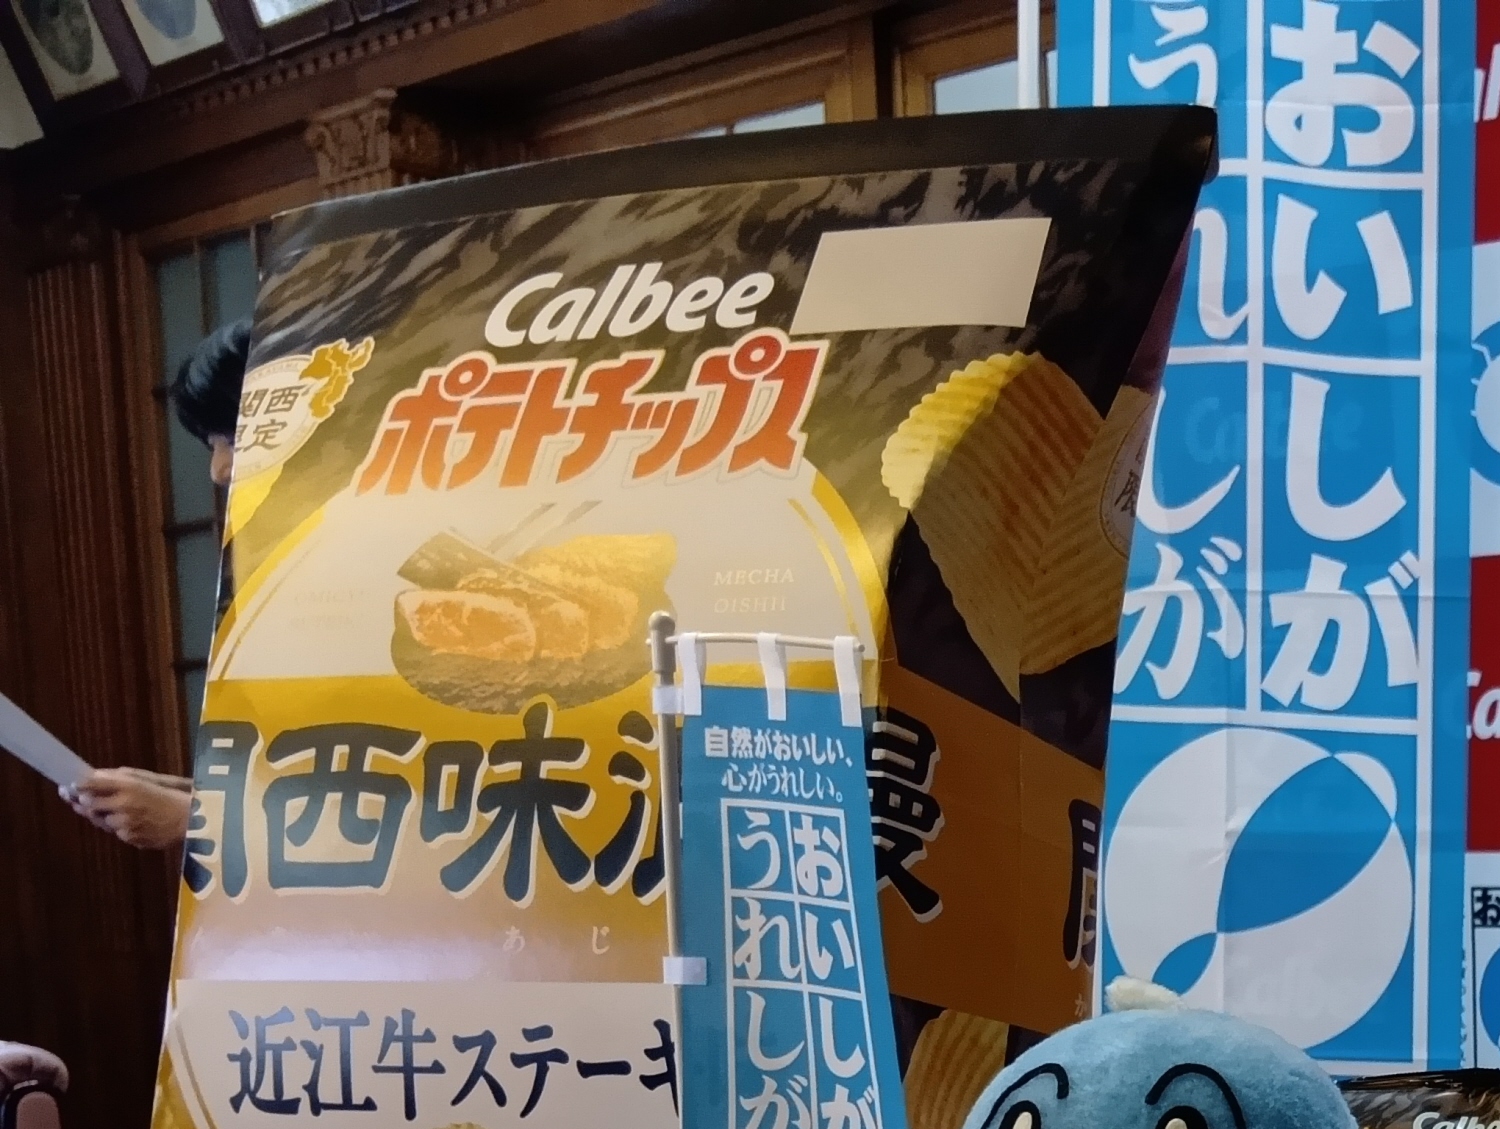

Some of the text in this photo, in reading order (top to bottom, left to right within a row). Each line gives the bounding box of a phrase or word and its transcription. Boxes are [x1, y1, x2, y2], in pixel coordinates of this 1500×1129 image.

[485, 264, 774, 348] Calbee
[356, 332, 826, 496] ポテトチップス
[714, 568, 794, 586] MECHA
